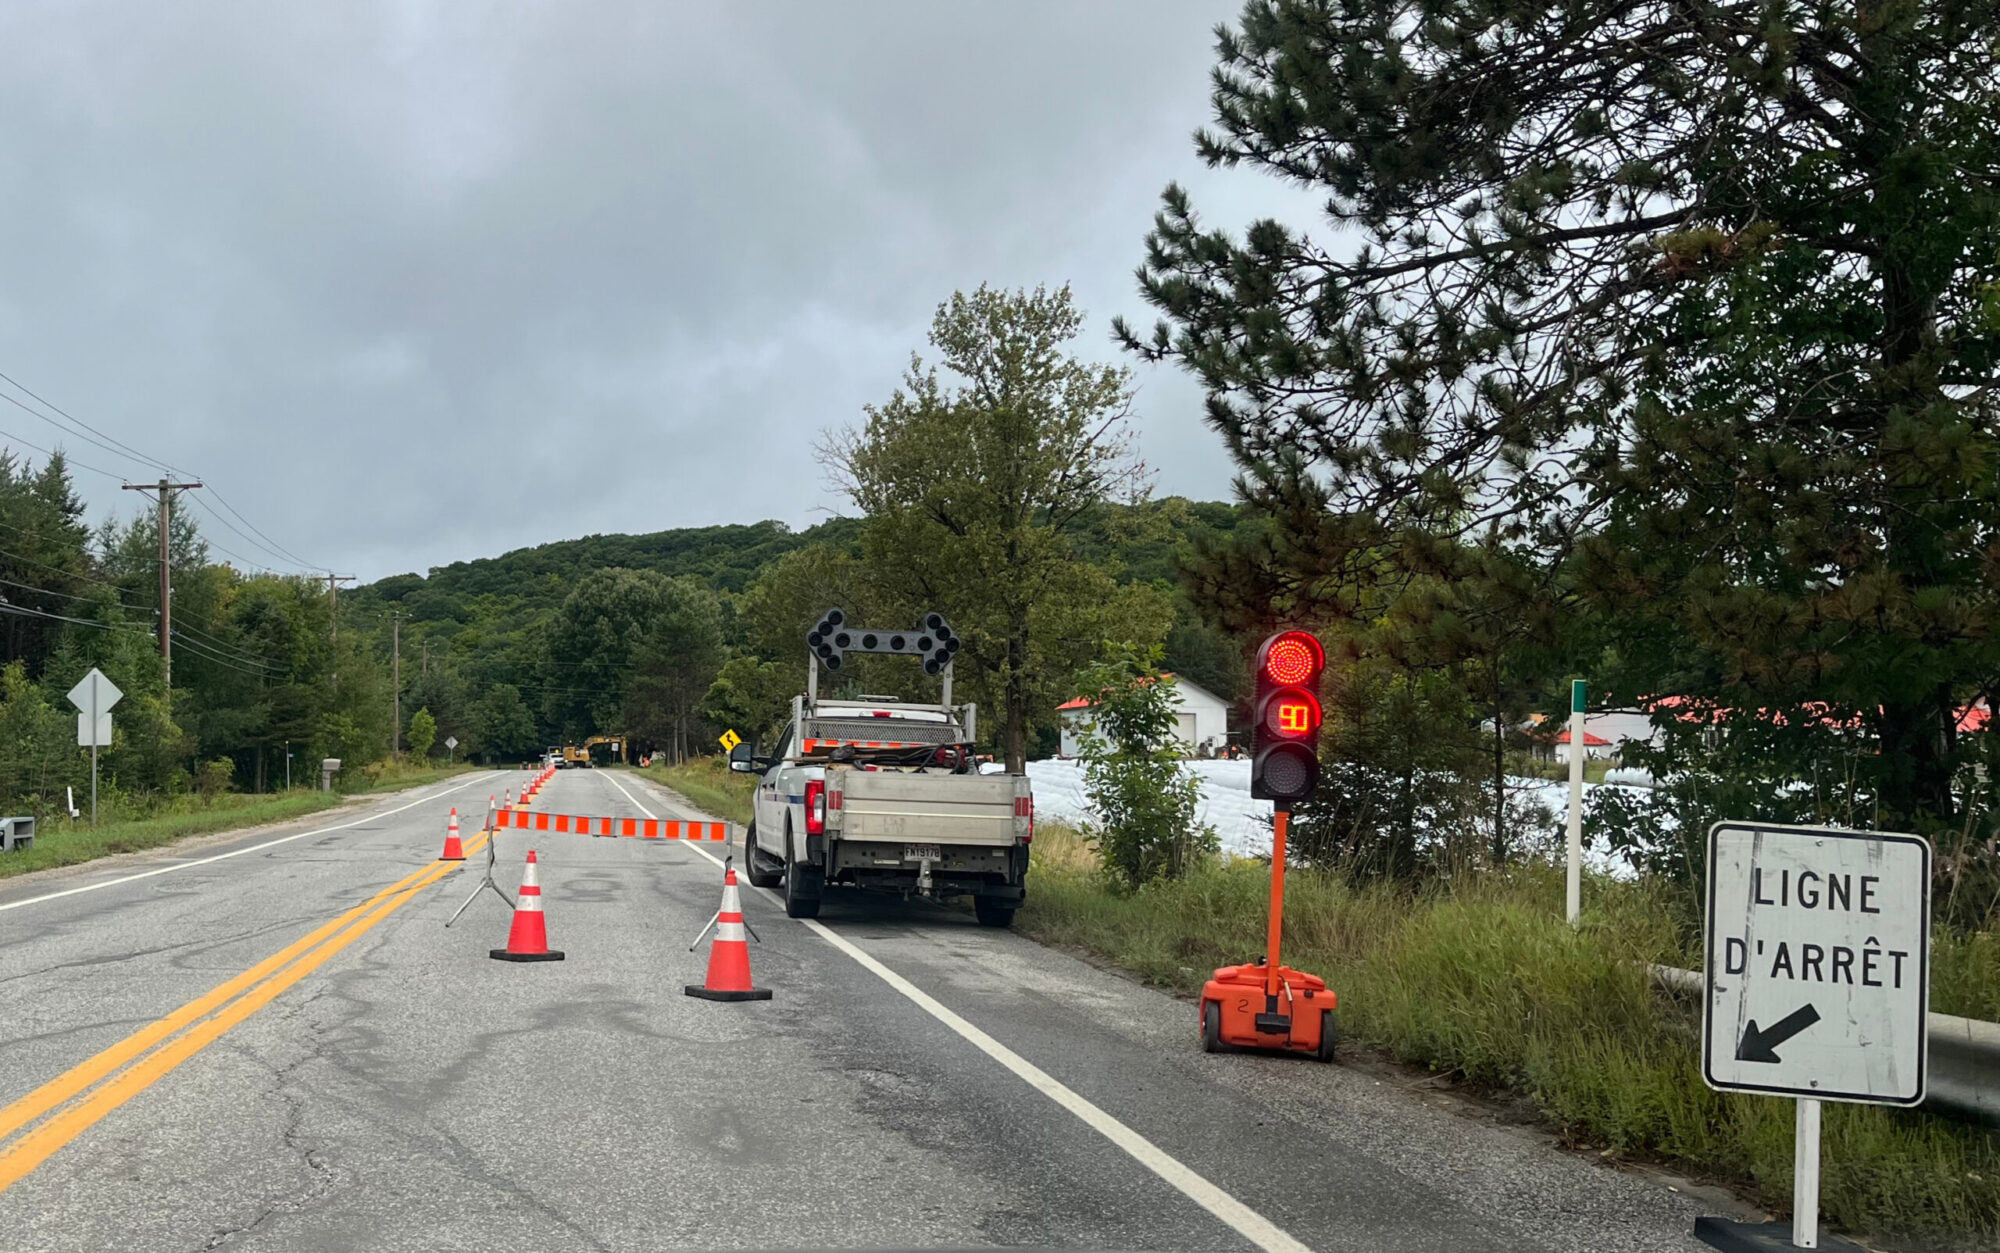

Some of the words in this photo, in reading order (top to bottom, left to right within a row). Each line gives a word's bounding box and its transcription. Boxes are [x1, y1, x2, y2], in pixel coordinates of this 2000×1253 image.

[1280, 704, 1308, 731] 90
[1754, 867, 1881, 914] LIGNE
[1725, 936, 1909, 989] D'ARRÊT
[1237, 999, 1249, 1013] 2
